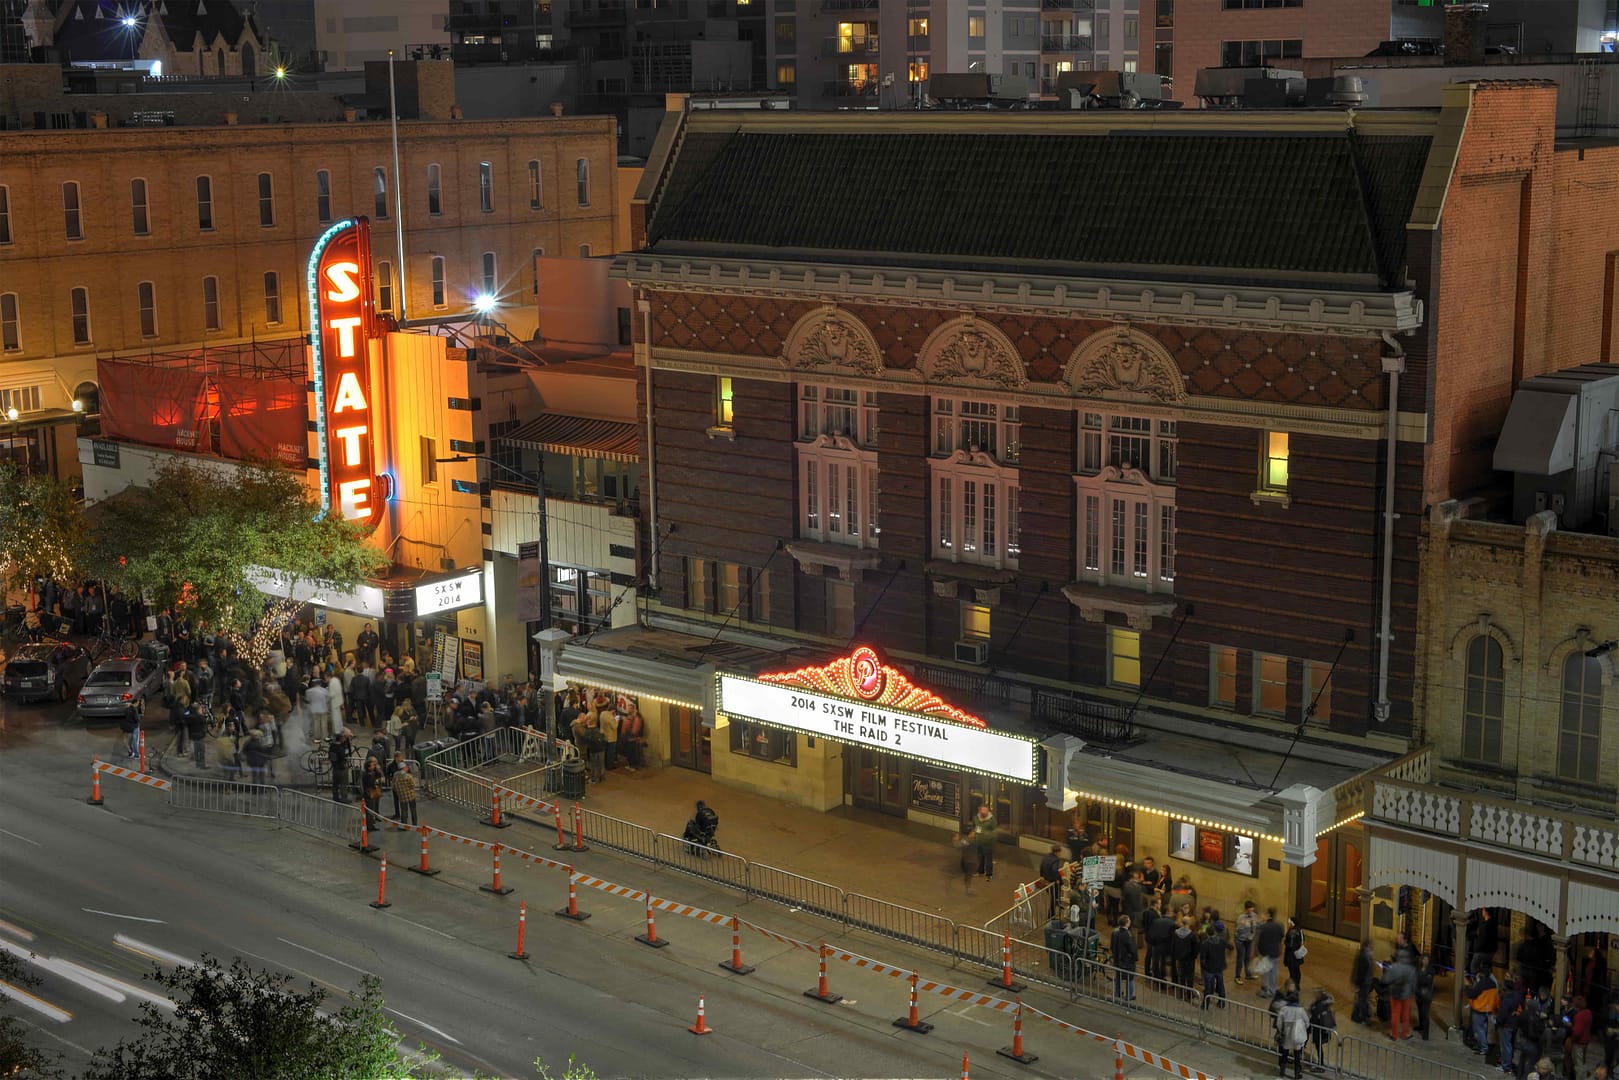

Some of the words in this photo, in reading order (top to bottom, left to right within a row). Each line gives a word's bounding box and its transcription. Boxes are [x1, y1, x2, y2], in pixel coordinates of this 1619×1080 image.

[324, 261, 372, 521] STATE
[435, 581, 462, 595] SXSW
[439, 595, 461, 607] 2014
[791, 696, 815, 711] 2014
[823, 703, 854, 719] SXSW
[861, 711, 887, 727] FILM
[894, 718, 949, 741] FESTIVAL
[834, 720, 855, 735] THE
[860, 726, 888, 742] RAID
[895, 734, 902, 746] 2
